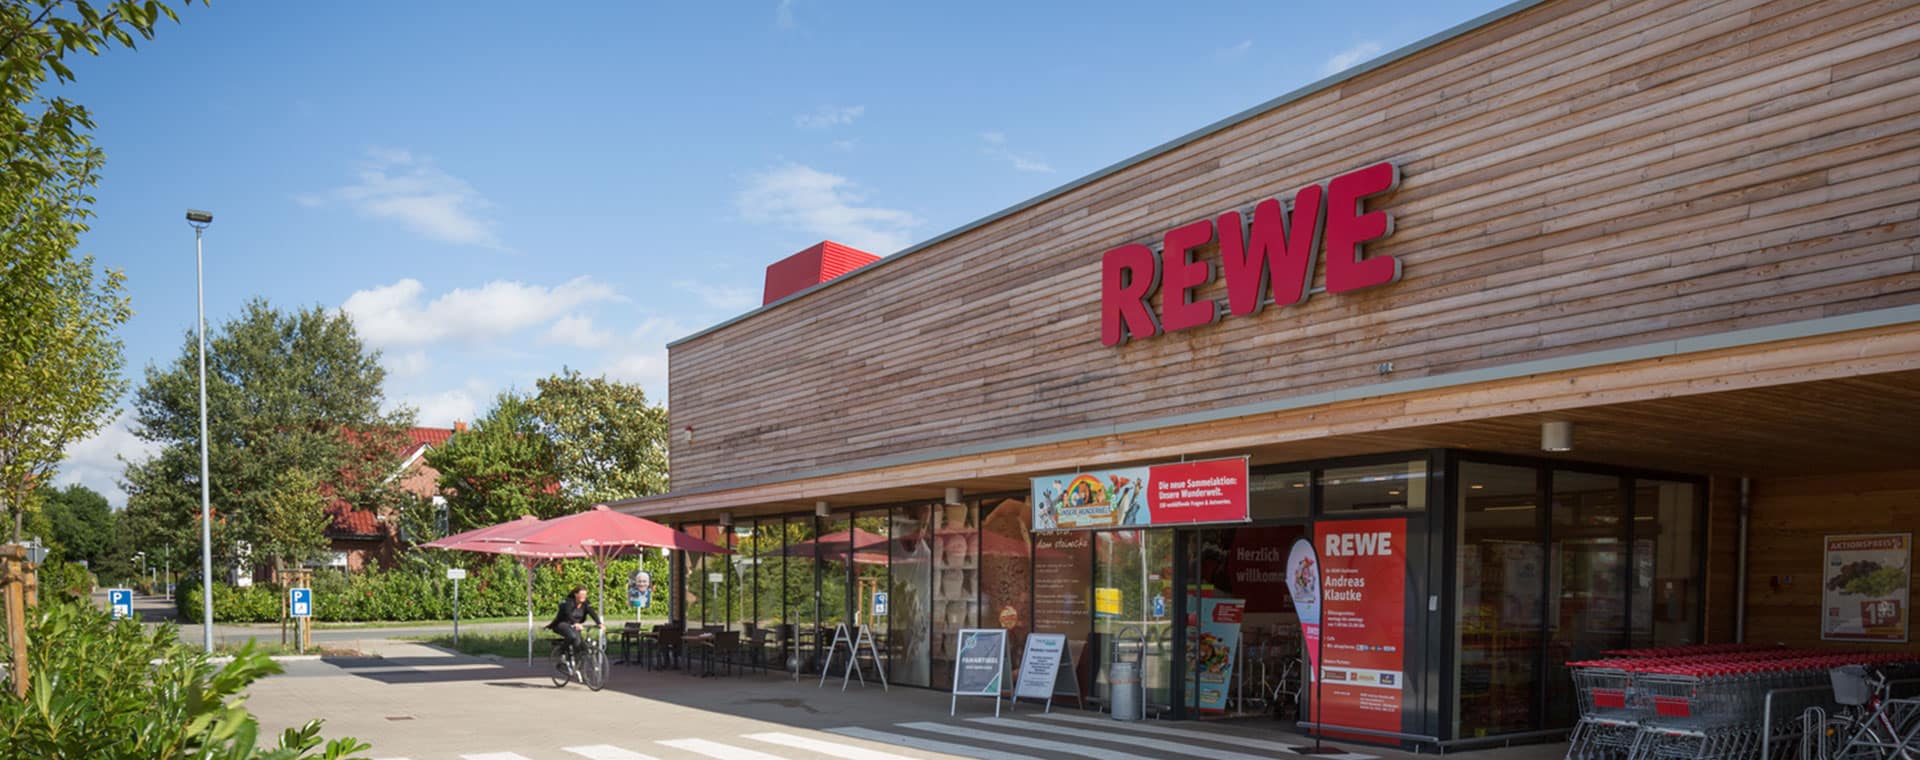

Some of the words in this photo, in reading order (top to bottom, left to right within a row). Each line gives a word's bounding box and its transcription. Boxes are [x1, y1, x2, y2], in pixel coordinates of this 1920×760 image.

[1101, 162, 1401, 346] REWE
[1158, 480, 1169, 490] Die
[1170, 480, 1186, 489] neue
[1187, 475, 1237, 488] Sammelaktion:
[1159, 491, 1180, 500] Unsere
[1181, 487, 1223, 498] Wunderwelt.
[1325, 531, 1393, 557] REWE
[1236, 547, 1280, 562] Herzlich
[1325, 575, 1366, 588] Andreas
[113, 592, 123, 604] P
[294, 591, 303, 602] P
[1324, 588, 1363, 602] Klautke
